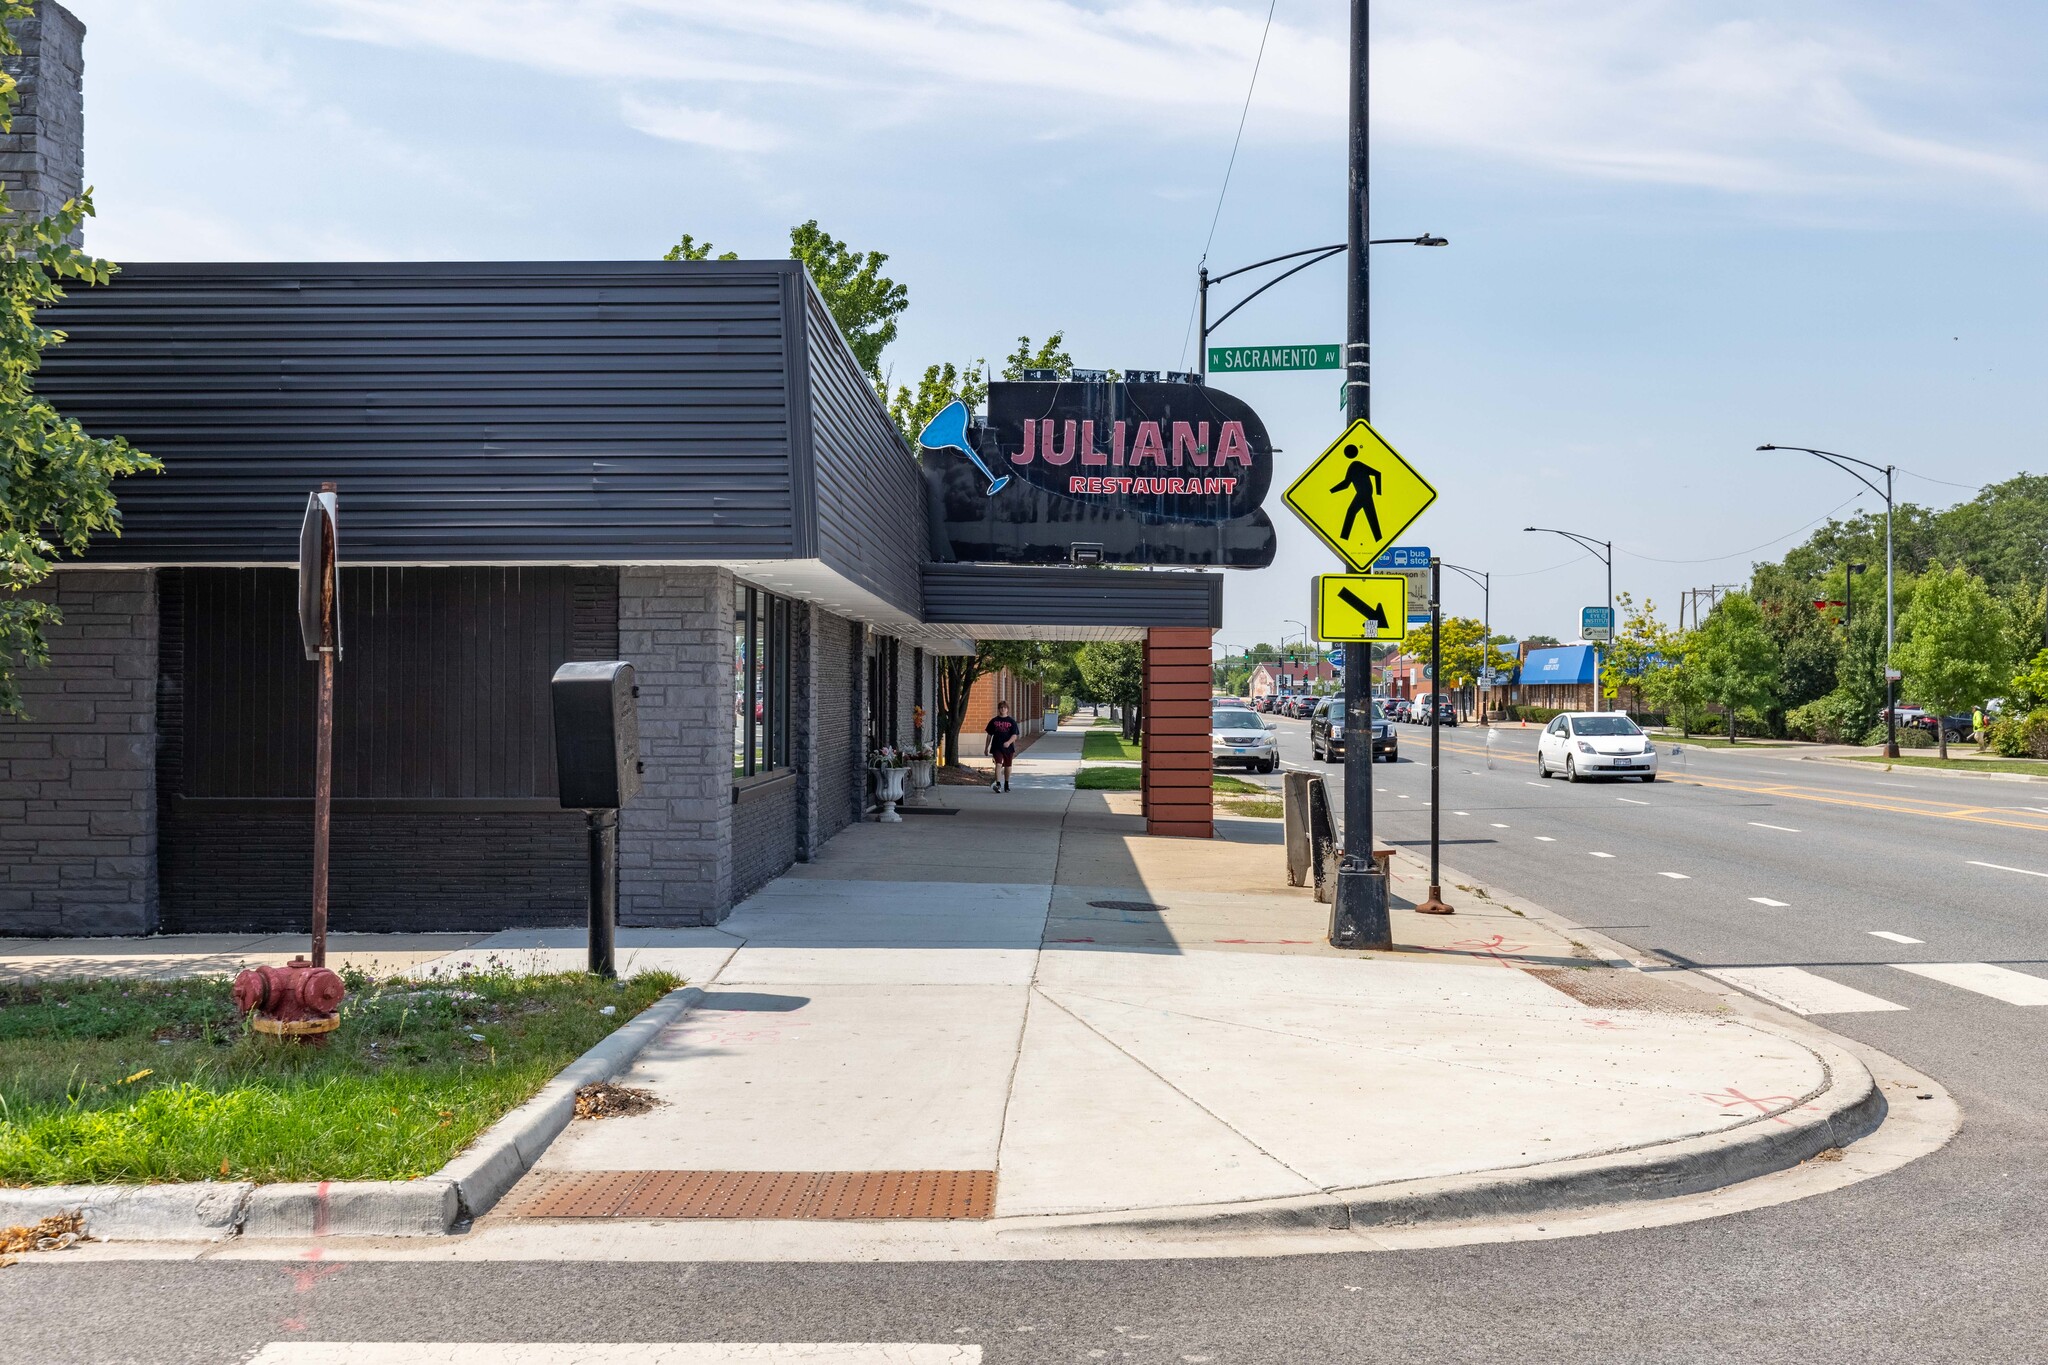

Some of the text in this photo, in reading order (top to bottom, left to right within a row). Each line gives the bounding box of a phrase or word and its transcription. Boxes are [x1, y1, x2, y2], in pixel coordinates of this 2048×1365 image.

[1213, 348, 1335, 369] N SACRAMENTO AV
[1011, 418, 1252, 467] JULIANA
[1069, 475, 1237, 495] RESTAURANT
[1410, 549, 1425, 557] bus
[1410, 557, 1429, 566] stop
